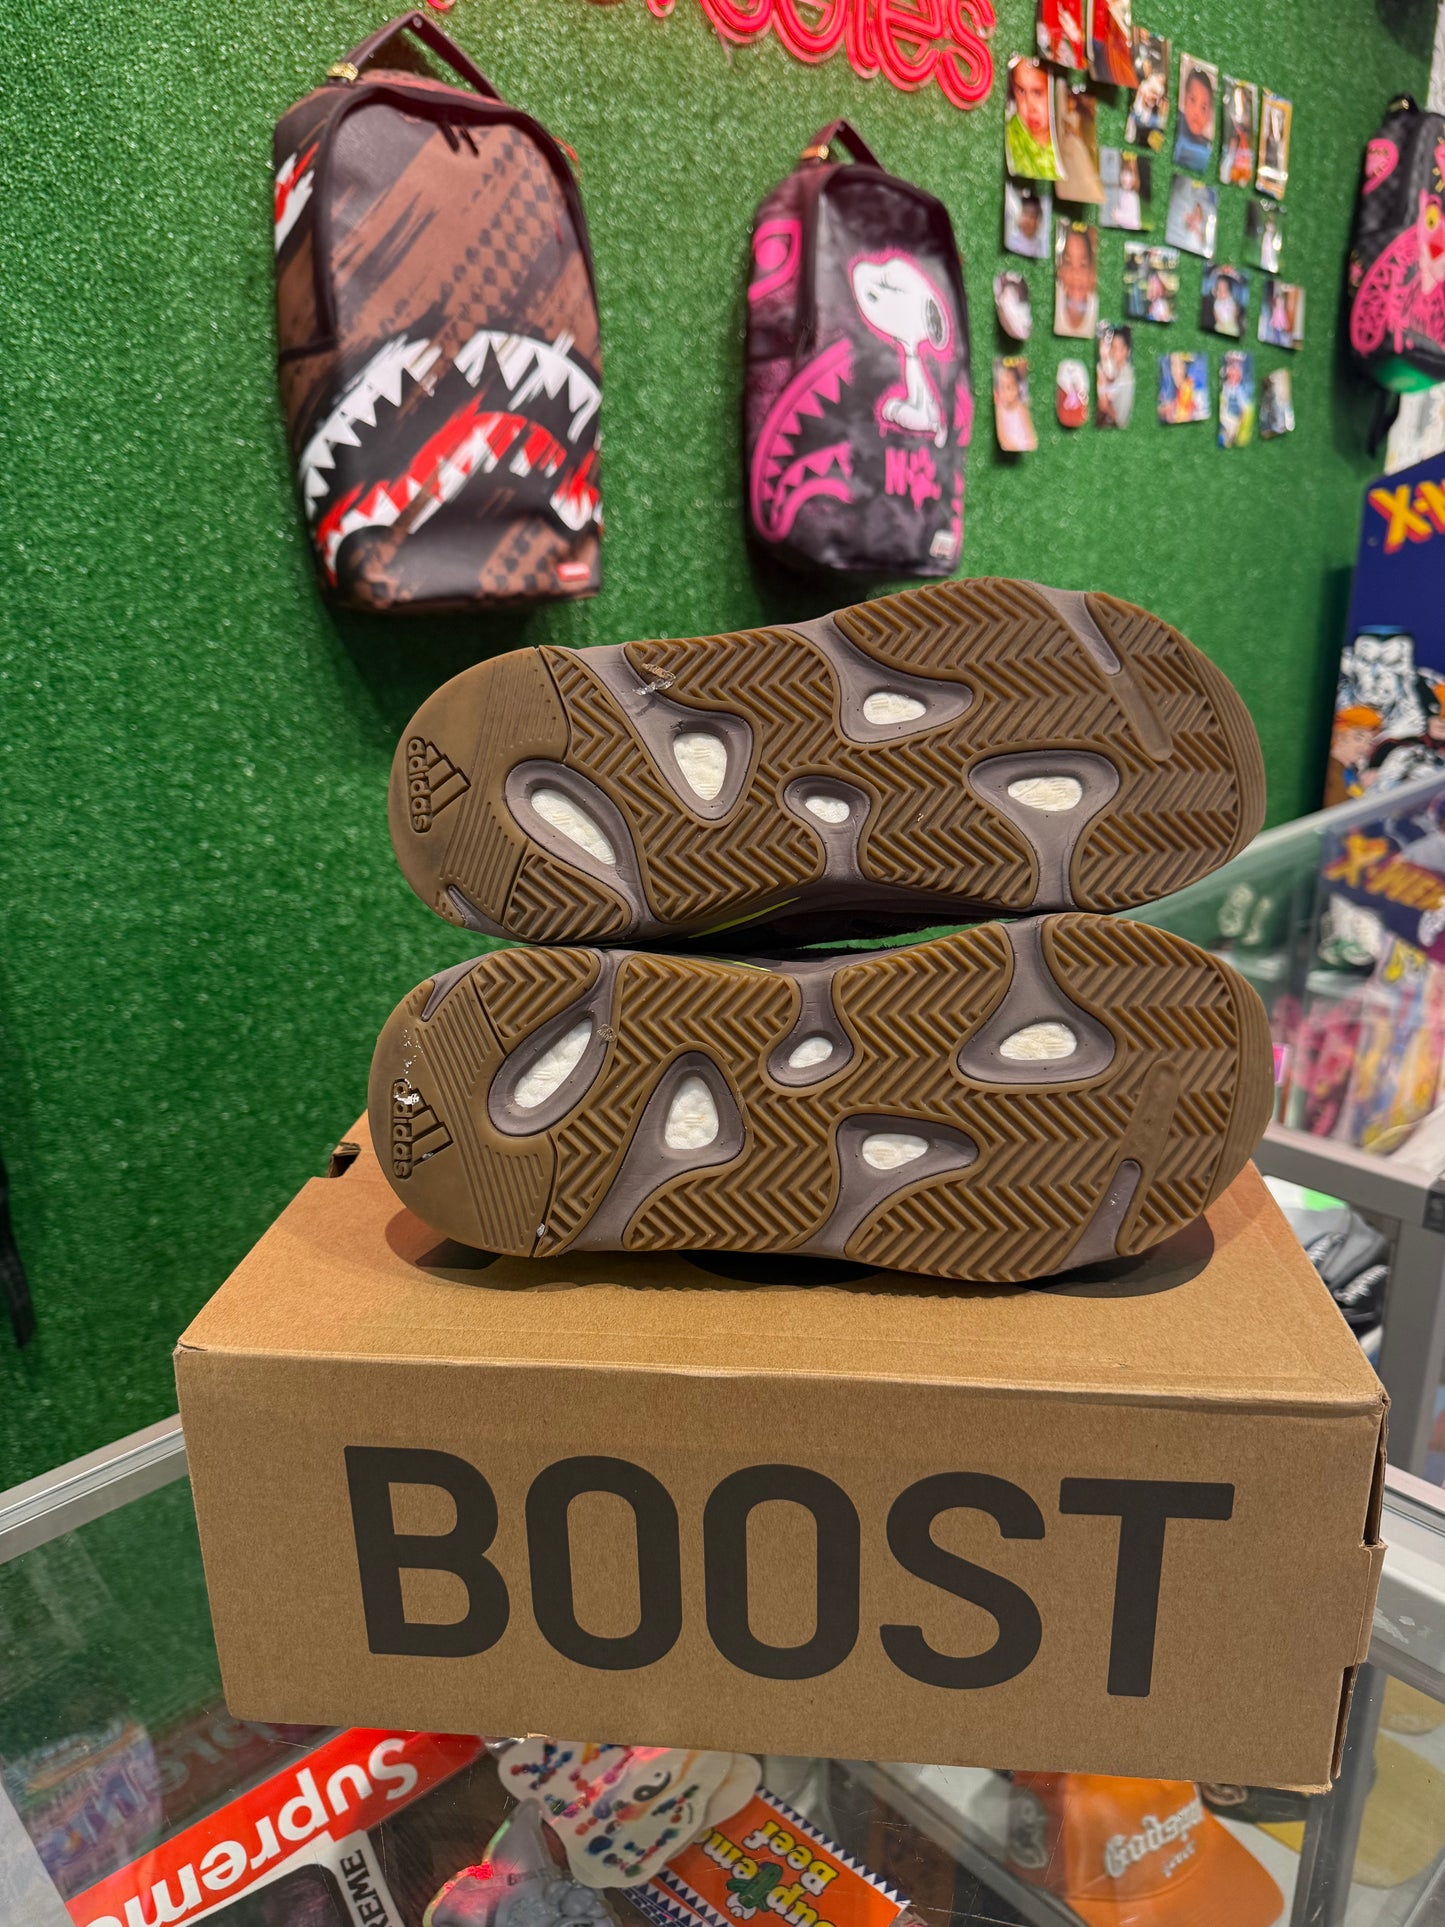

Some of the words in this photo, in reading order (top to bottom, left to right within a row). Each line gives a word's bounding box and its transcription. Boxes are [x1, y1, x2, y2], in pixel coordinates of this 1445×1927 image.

[407, 737, 433, 833] adidas
[392, 1079, 414, 1178] adidas
[344, 1445, 1235, 1697] BOOST
[86, 1737, 419, 1927] Suprem
[742, 1820, 839, 1897] Beef
